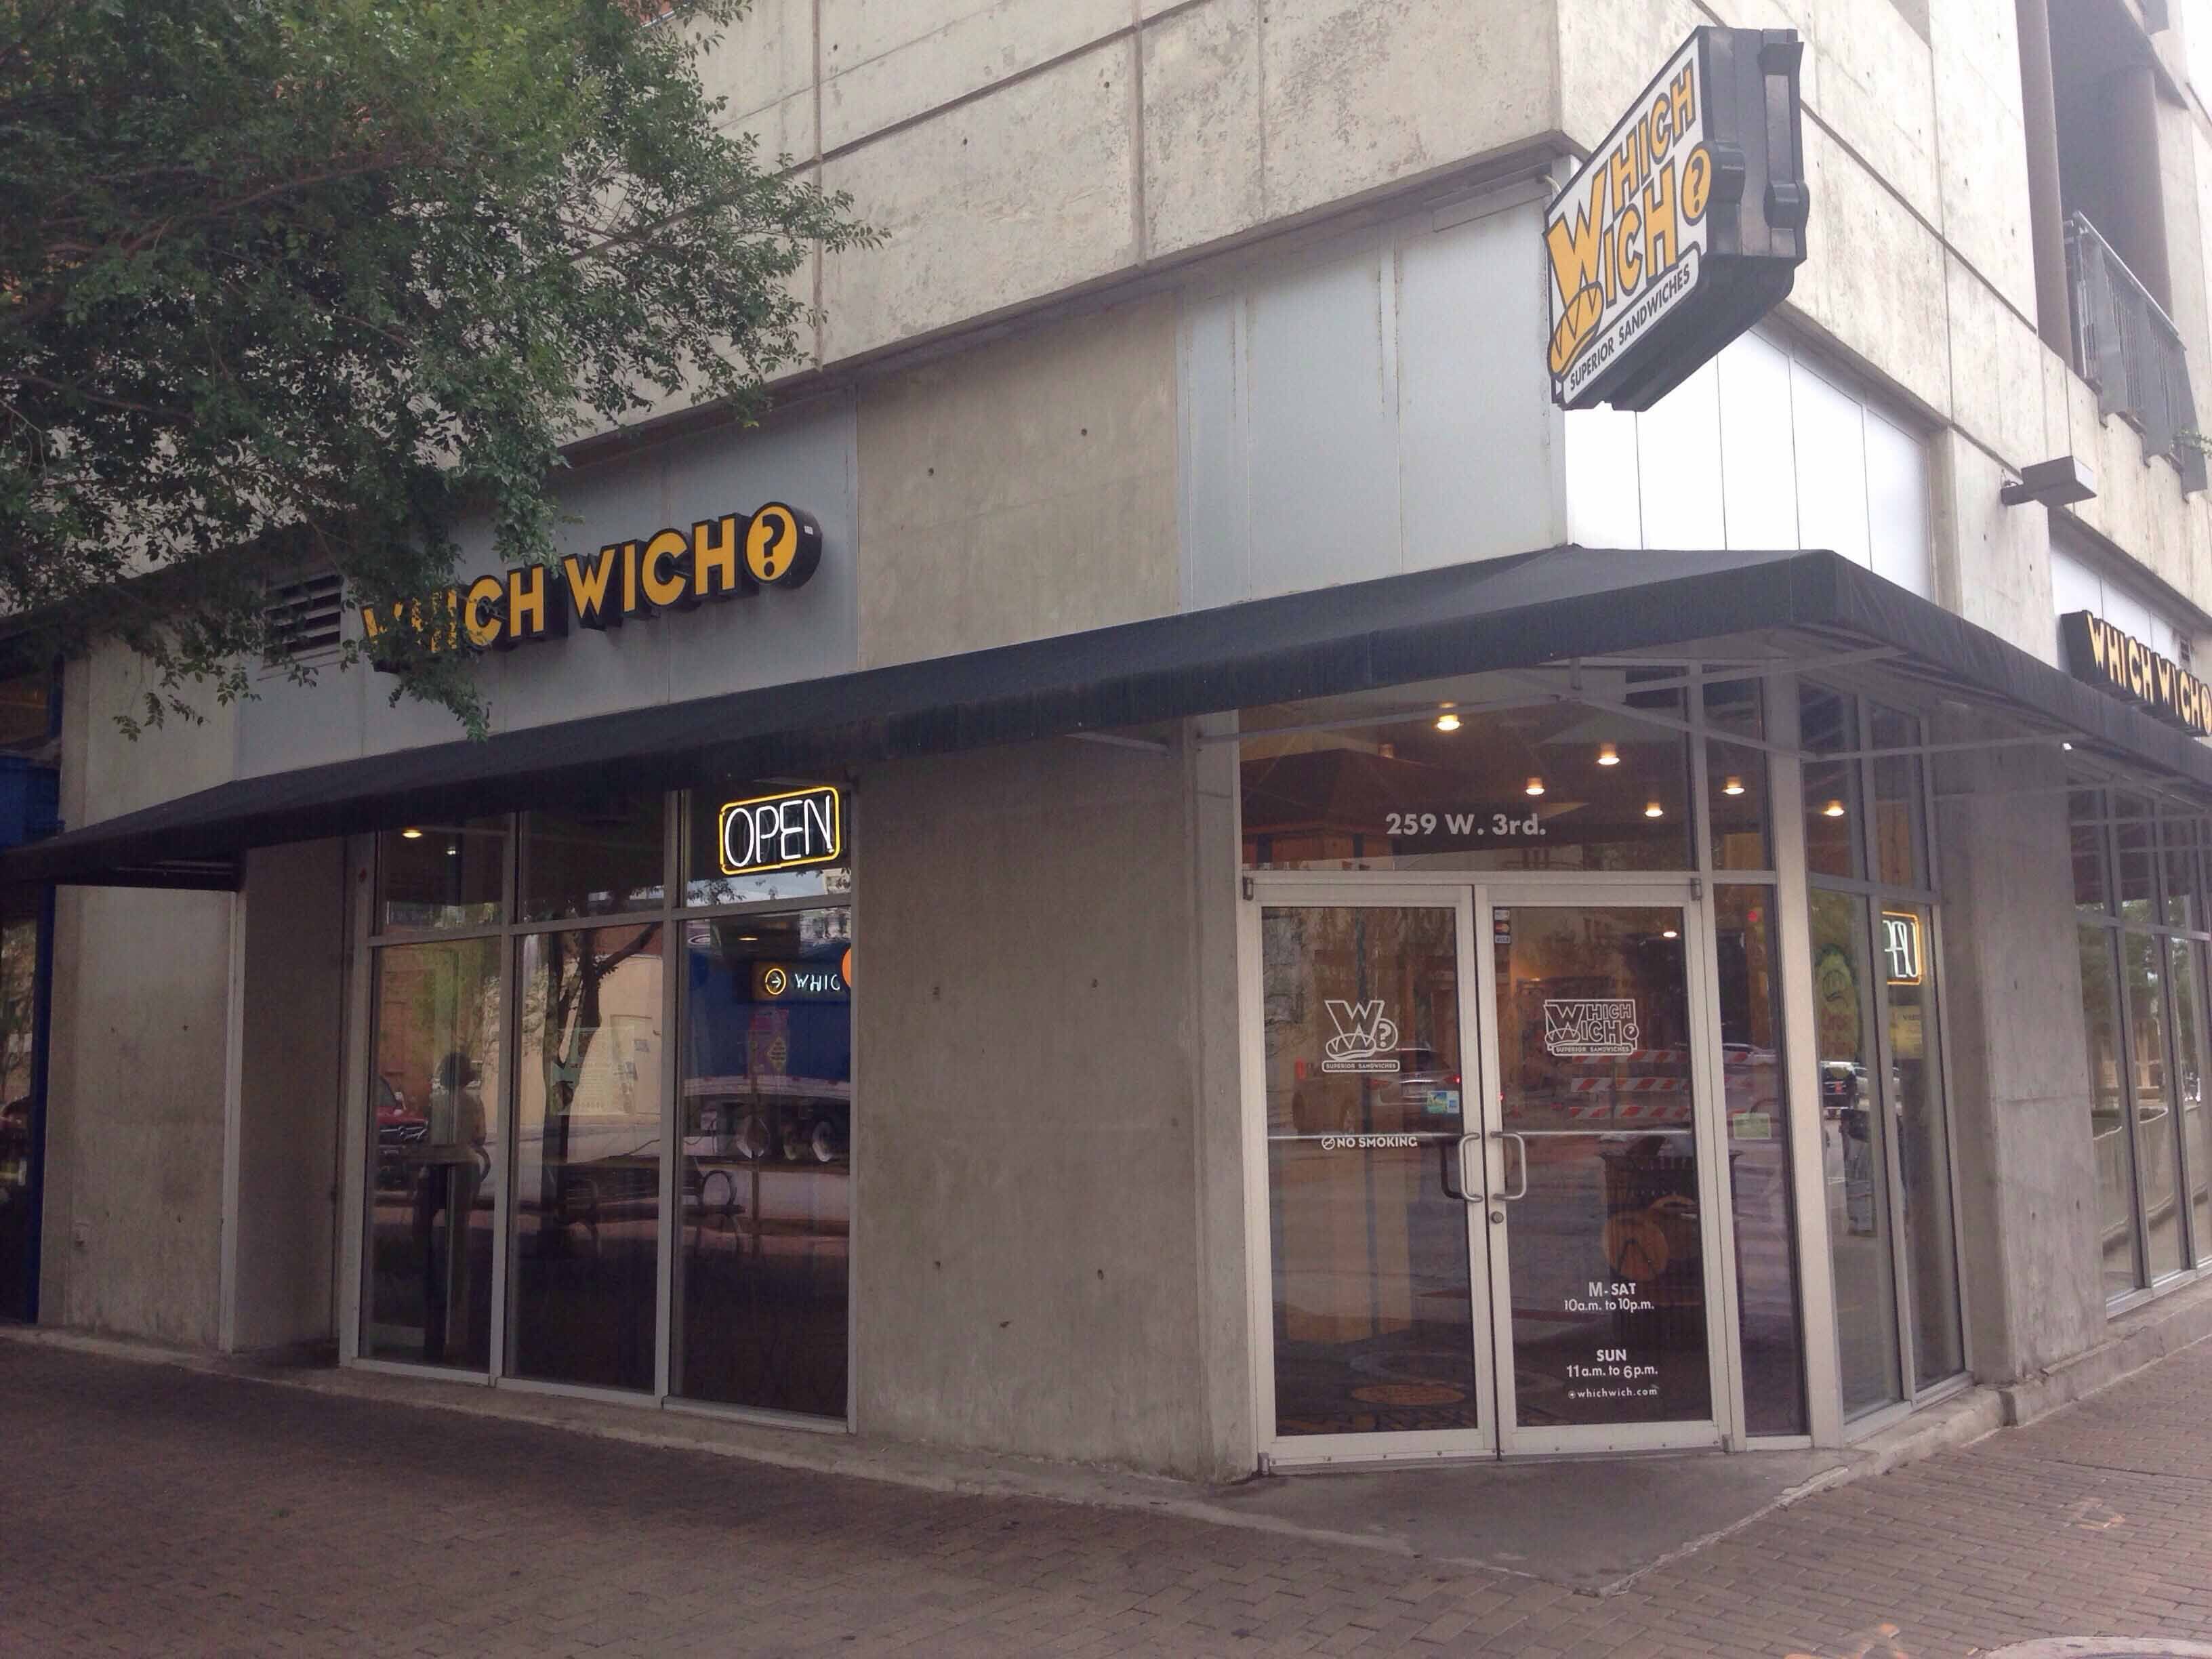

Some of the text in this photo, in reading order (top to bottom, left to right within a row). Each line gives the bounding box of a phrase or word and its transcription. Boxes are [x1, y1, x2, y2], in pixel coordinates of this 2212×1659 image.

[1570, 264, 1690, 391] SUPERIOR SANDWICHES
[2086, 611, 2154, 705] WHICH
[724, 794, 833, 867] OPEN
[1385, 813, 1547, 836] 259 W. 3rd.
[795, 972, 841, 991] WHIC
[1337, 1136, 1418, 1148] NO SMOKING
[1605, 1300, 1616, 1311] to
[1596, 1349, 1626, 1361] SUN
[1609, 1366, 1620, 1375] to
